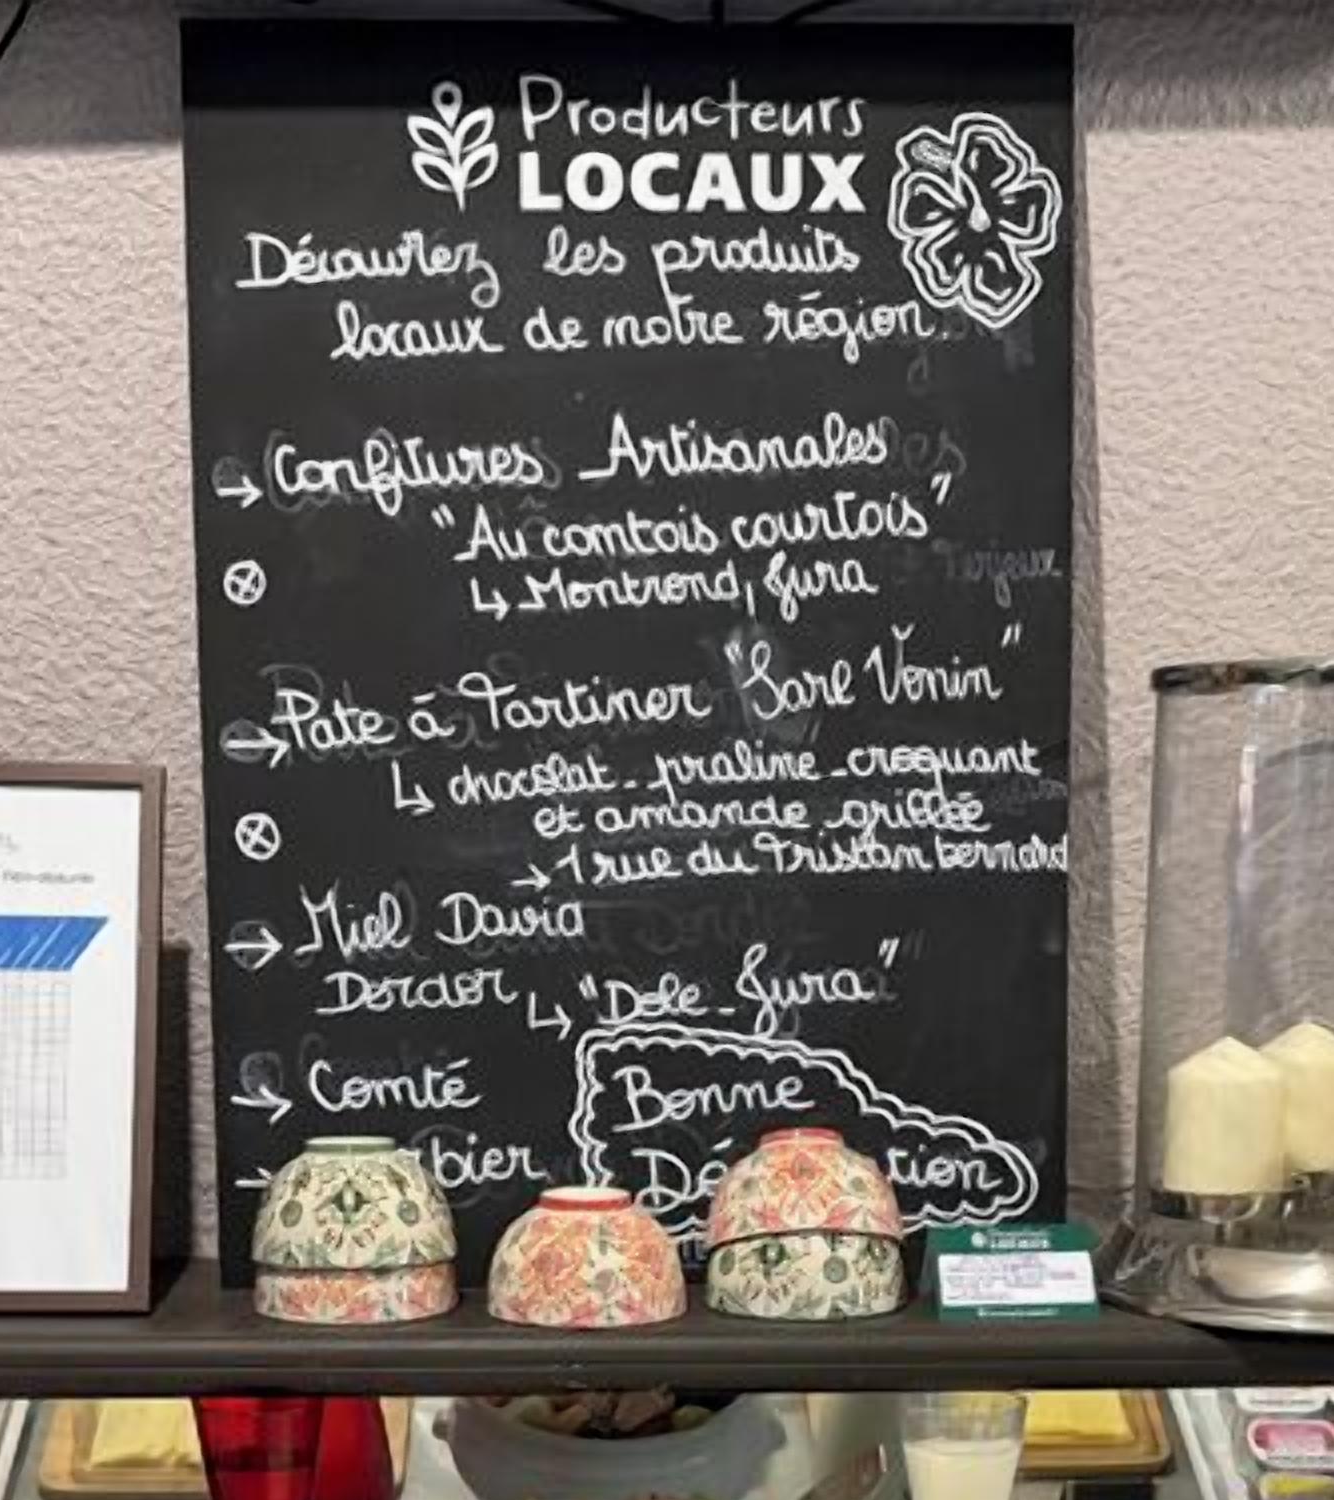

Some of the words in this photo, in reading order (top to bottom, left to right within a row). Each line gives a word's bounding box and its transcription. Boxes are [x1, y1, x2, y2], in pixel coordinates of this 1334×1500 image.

[519, 74, 865, 140] Producteurs
[519, 151, 866, 213] LOCAUX
[235, 231, 500, 308] Découvrez
[543, 224, 627, 276] les
[652, 223, 861, 298] produits
[330, 300, 505, 360] locaux
[523, 306, 588, 351] de
[603, 295, 745, 346] notre
[273, 436, 546, 515] Confitures
[578, 413, 889, 478] Artisanales
[542, 504, 721, 557] comtois
[764, 550, 881, 622] Jura
[458, 671, 713, 730] Tartiner
[448, 752, 617, 805] chocolat
[647, 739, 832, 808] praline
[846, 738, 1042, 802] croquant
[533, 802, 585, 839] et
[594, 796, 812, 833] amande
[591, 845, 683, 885] rue
[687, 839, 759, 876] du
[753, 831, 933, 874] Tristan
[294, 879, 412, 962] Miel
[435, 892, 586, 945] David
[308, 1058, 484, 1112] Comté
[612, 1065, 817, 1133] Bonne
[405, 1135, 550, 1188] bier
